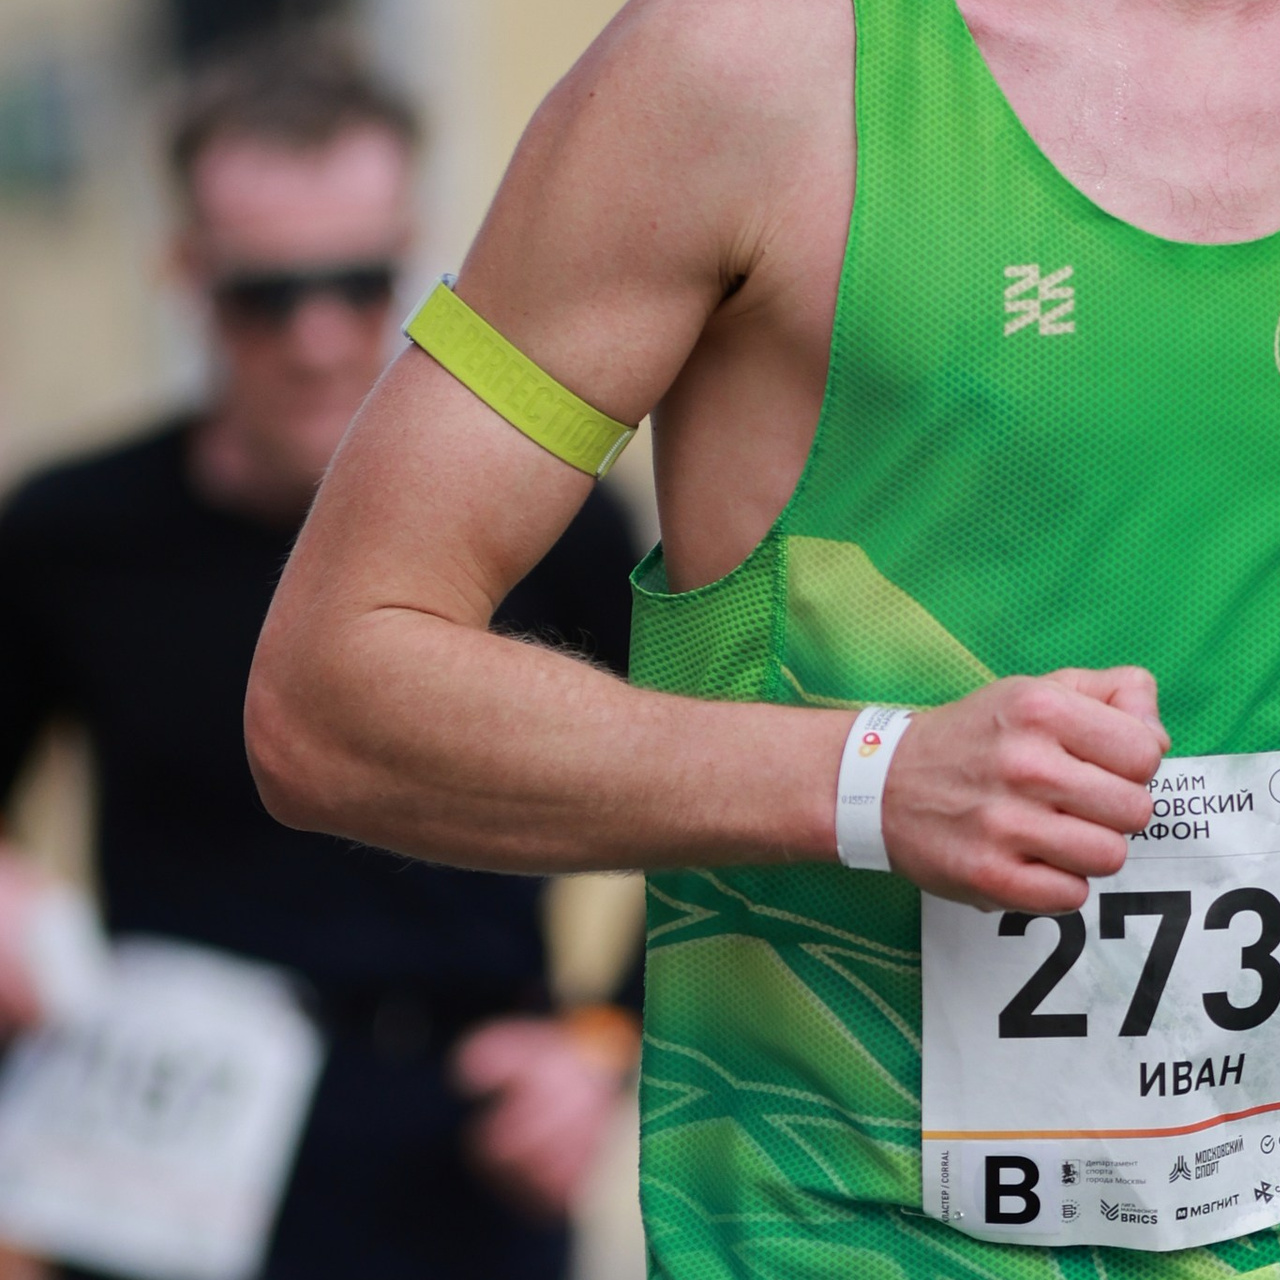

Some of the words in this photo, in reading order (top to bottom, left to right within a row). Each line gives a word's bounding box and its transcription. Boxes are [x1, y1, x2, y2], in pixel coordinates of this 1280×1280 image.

[1149, 774, 1205, 793] РАЙМ
[1153, 789, 1254, 818] ОВСКИЙ
[1130, 820, 1210, 841] АФОН
[1140, 1053, 1246, 1097] ИВАН
[1194, 1134, 1245, 1166] МОСКОВСКИЙ
[940, 1149, 950, 1184] CORRAL
[1085, 1160, 1139, 1168] Департамент
[1085, 1168, 1113, 1176] спорта
[1194, 1160, 1221, 1181] СПОРТ
[1085, 1177, 1113, 1185] города
[1114, 1177, 1147, 1185] Москвы
[1120, 1213, 1159, 1226] BRICS
